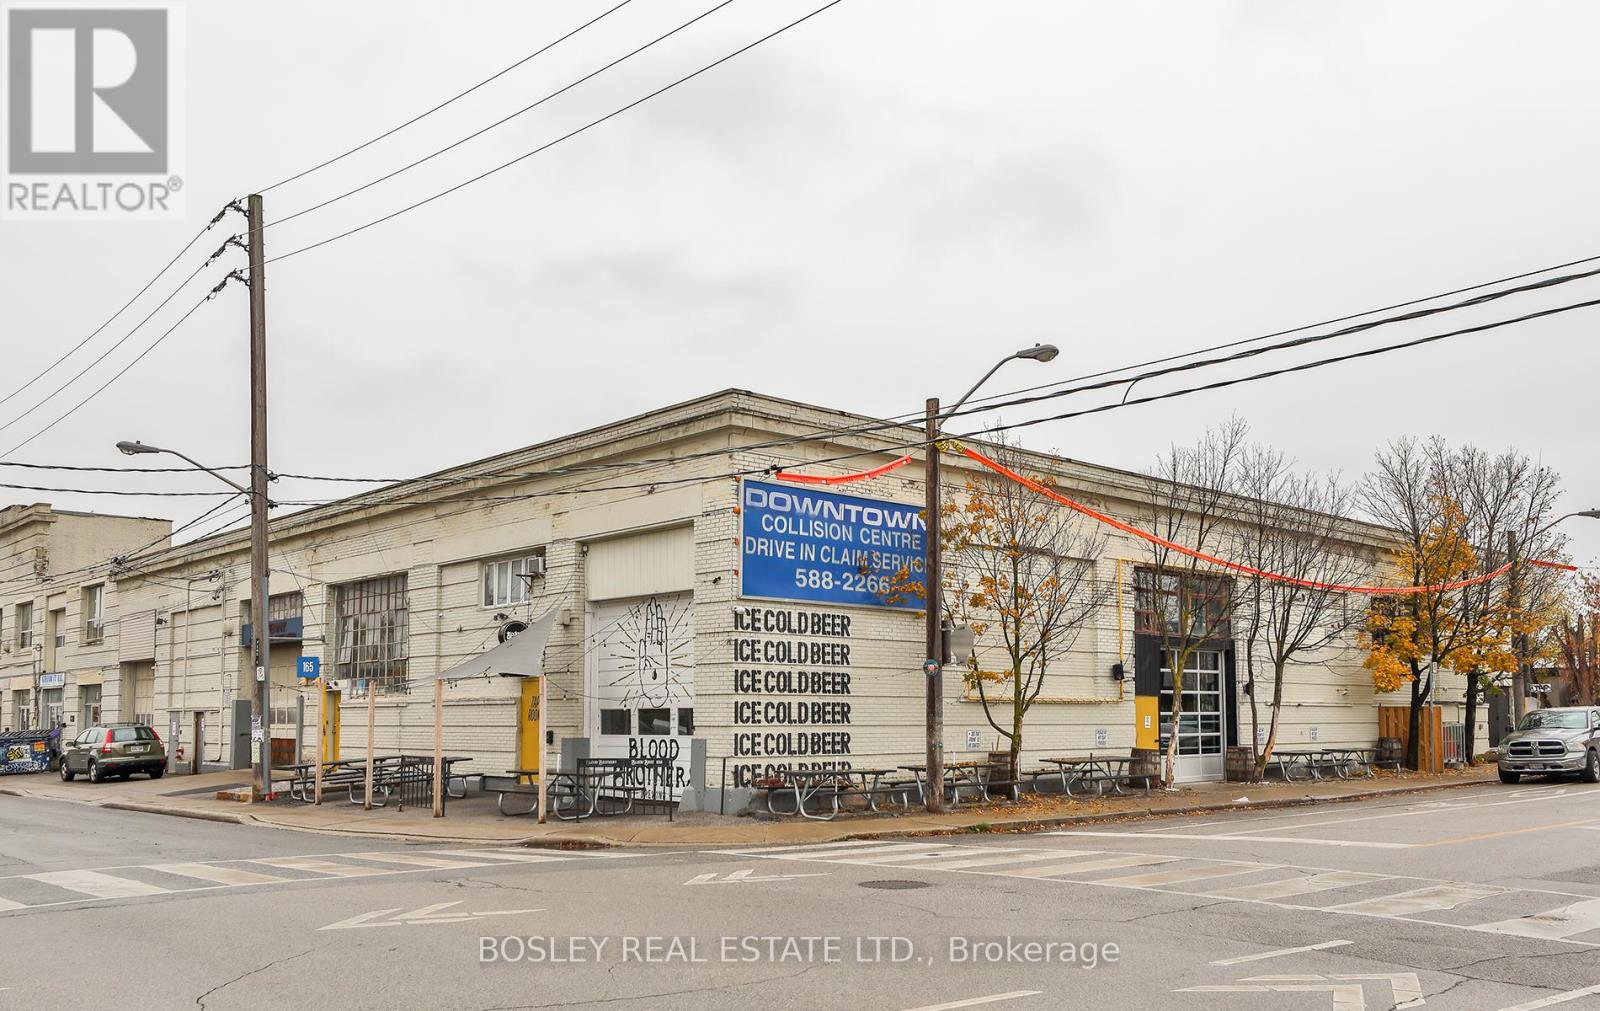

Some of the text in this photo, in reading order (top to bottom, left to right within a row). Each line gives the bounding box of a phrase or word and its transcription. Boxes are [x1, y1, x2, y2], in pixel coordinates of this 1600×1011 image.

[746, 487, 926, 531] DOWNTOWN
[762, 514, 921, 550] COLLISION CENTRE
[745, 536, 926, 575] DRIVE IN CLAIM SERVIC
[795, 568, 890, 594] 588-2266
[734, 608, 851, 636] ICE COLD BEER
[734, 639, 851, 665] ICE COLD BEER
[303, 661, 314, 673] 165
[734, 669, 851, 694] ICE COLD BEER
[734, 701, 851, 724] ICE COLD BEER
[628, 738, 680, 761] BLOOD
[734, 732, 851, 756] ICE COLD BEER
[734, 763, 761, 788] ICE
